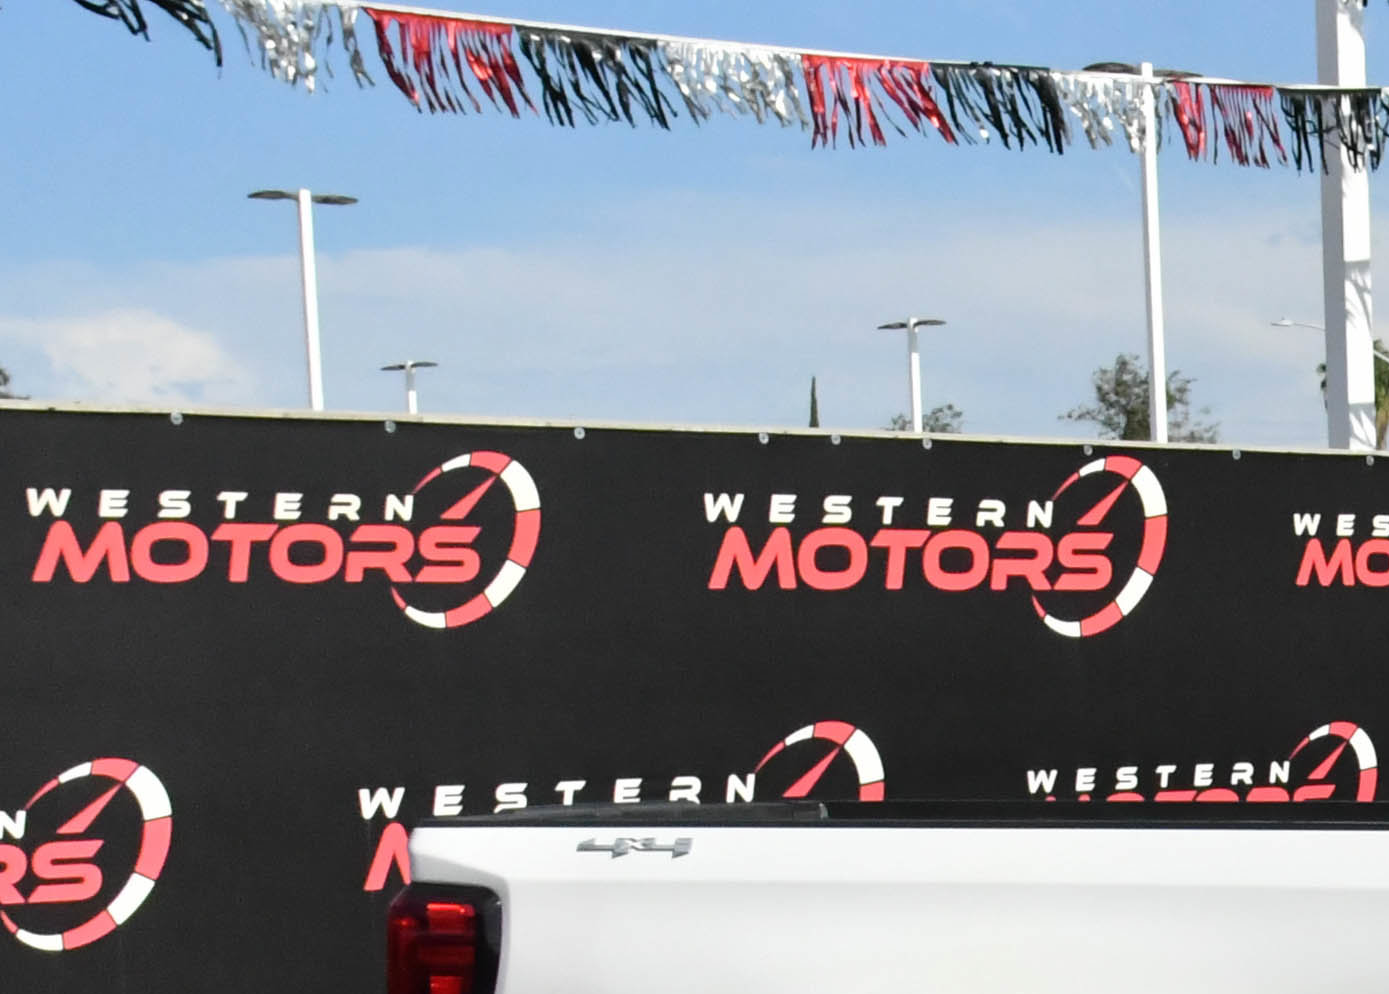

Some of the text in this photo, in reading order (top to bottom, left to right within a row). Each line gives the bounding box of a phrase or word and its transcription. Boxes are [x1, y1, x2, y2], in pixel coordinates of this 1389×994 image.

[26, 487, 414, 521] WESTERN
[704, 492, 1054, 528] WESTERN
[31, 519, 482, 584] MOTORS
[708, 525, 1114, 592] MOTORS
[358, 773, 756, 820] WESTERN
[1027, 760, 1291, 794] WESTERN
